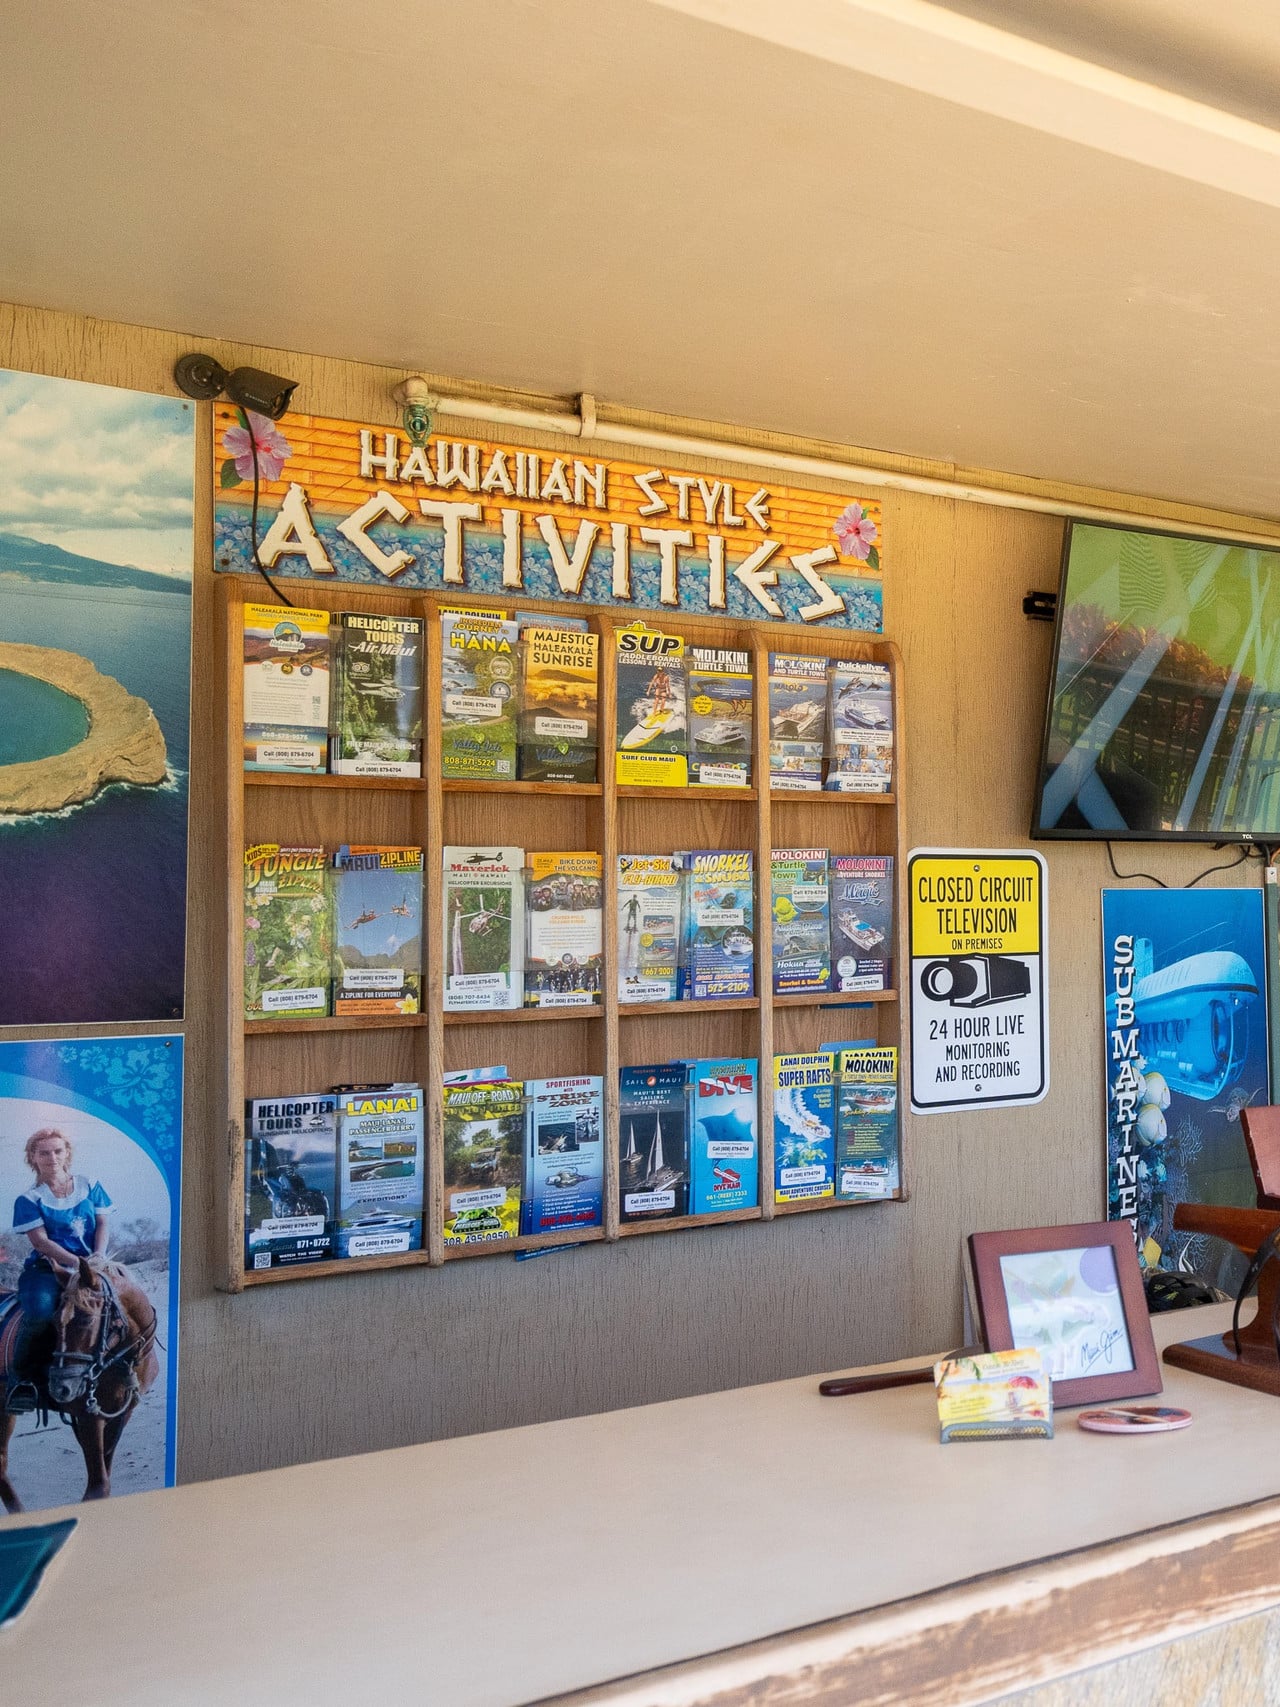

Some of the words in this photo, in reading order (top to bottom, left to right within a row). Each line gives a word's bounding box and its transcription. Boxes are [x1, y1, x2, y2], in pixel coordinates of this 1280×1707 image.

[357, 428, 608, 508] HAWAIIAN
[635, 468, 771, 531] STYLE
[254, 482, 850, 623] ACTIVITIES
[348, 617, 419, 634] HELICOPTER
[453, 623, 499, 634] JOURNEY
[460, 618, 503, 628] INCREDIBLE
[365, 630, 405, 644] TOURS
[450, 631, 512, 653] HĀNA
[534, 631, 594, 645] MAJESTIC
[378, 644, 417, 656] Maui
[619, 634, 680, 655] SUP
[533, 652, 593, 668] SUNRISE
[619, 653, 681, 663] PADDLEBOARD
[693, 649, 748, 664] MOLOKINI
[694, 662, 724, 671] TURTLE
[726, 664, 748, 673] TOWN
[775, 659, 825, 671] MOLOKINI
[837, 661, 886, 672] Quicksilver
[444, 757, 496, 767] 808-871-5224
[246, 848, 262, 862] KIDS
[342, 856, 379, 871] MAUI
[380, 850, 421, 865] ZIPLINE
[771, 851, 826, 860] MOLOKINI
[450, 864, 510, 872] Maverick
[632, 860, 649, 870] Jet
[652, 859, 671, 870] Ski
[694, 853, 750, 873] SNORKEL
[779, 862, 806, 870] Turtle
[836, 859, 886, 870] MOLOKINI
[248, 853, 327, 889] JUNGLE
[772, 871, 796, 879] Town
[278, 875, 323, 894] ZIPLINE
[705, 872, 750, 884] SNUBA
[918, 876, 973, 902] CLOSED
[980, 877, 1033, 902] CIRCUIT
[937, 908, 1017, 935] TELEVISION
[951, 939, 962, 950] ON
[965, 938, 1003, 949] PREMISES
[929, 1019, 948, 1040] 24
[954, 1017, 990, 1039] HOUR
[996, 1014, 1025, 1035] LIVE
[946, 1041, 1010, 1061] MONITORING
[781, 1058, 799, 1066] LANAI
[802, 1055, 829, 1065] DOLPHIN
[845, 1060, 894, 1073] MOLOKINI
[779, 1070, 804, 1087] SUPER
[806, 1069, 831, 1084] RAFTS
[935, 1065, 957, 1083] AND
[961, 1061, 1020, 1081] RECORDING
[546, 1079, 591, 1089] SPORTFISHING
[699, 1075, 753, 1097] DIVE
[1111, 934, 1145, 1246] SUBMARINE
[448, 1092, 470, 1105] MAUI
[537, 1091, 599, 1102] STRIKE
[549, 1098, 592, 1108] ZONE
[258, 1101, 334, 1118] HELICOPTER
[259, 1117, 302, 1130] TOURS
[349, 1125, 386, 1135] PASSENGER
[388, 1124, 415, 1132] FERRY
[258, 1129, 290, 1137] SUNSHINE
[791, 1186, 814, 1194] ADVENTURE
[1080, 1342, 1100, 1367] Maui
[1099, 1326, 1124, 1364] Jim
